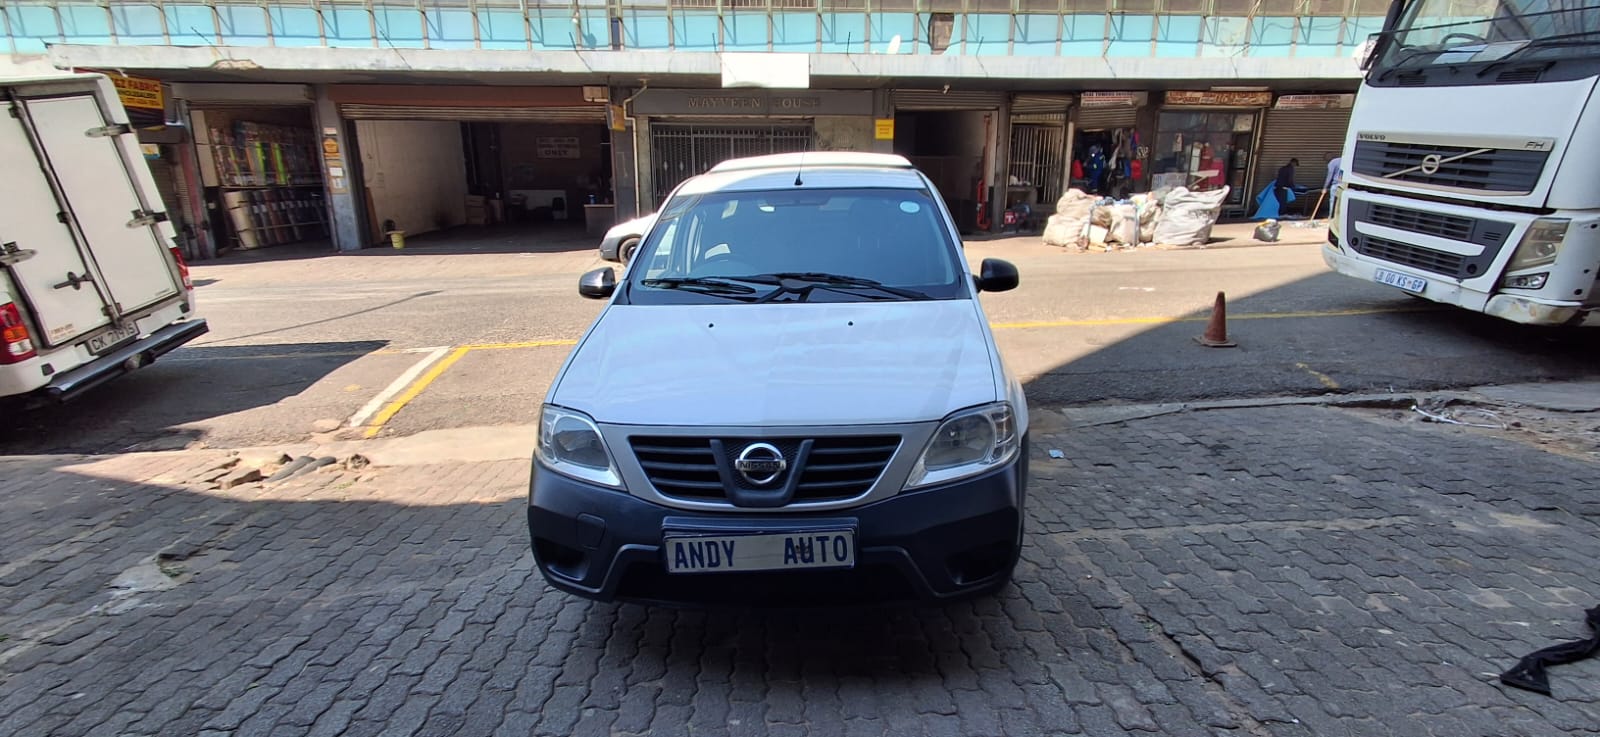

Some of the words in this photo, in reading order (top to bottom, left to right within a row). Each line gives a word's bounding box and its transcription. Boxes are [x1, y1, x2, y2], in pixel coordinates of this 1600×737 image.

[127, 79, 160, 92] FABRIC
[688, 96, 761, 109] MAYVEEN
[1359, 133, 1386, 141] VOLVO
[1524, 141, 1546, 149] FH
[91, 336, 107, 350] CK
[739, 461, 784, 470] NISSAN
[674, 540, 735, 569] ANDY
[783, 535, 848, 565] AUTO
